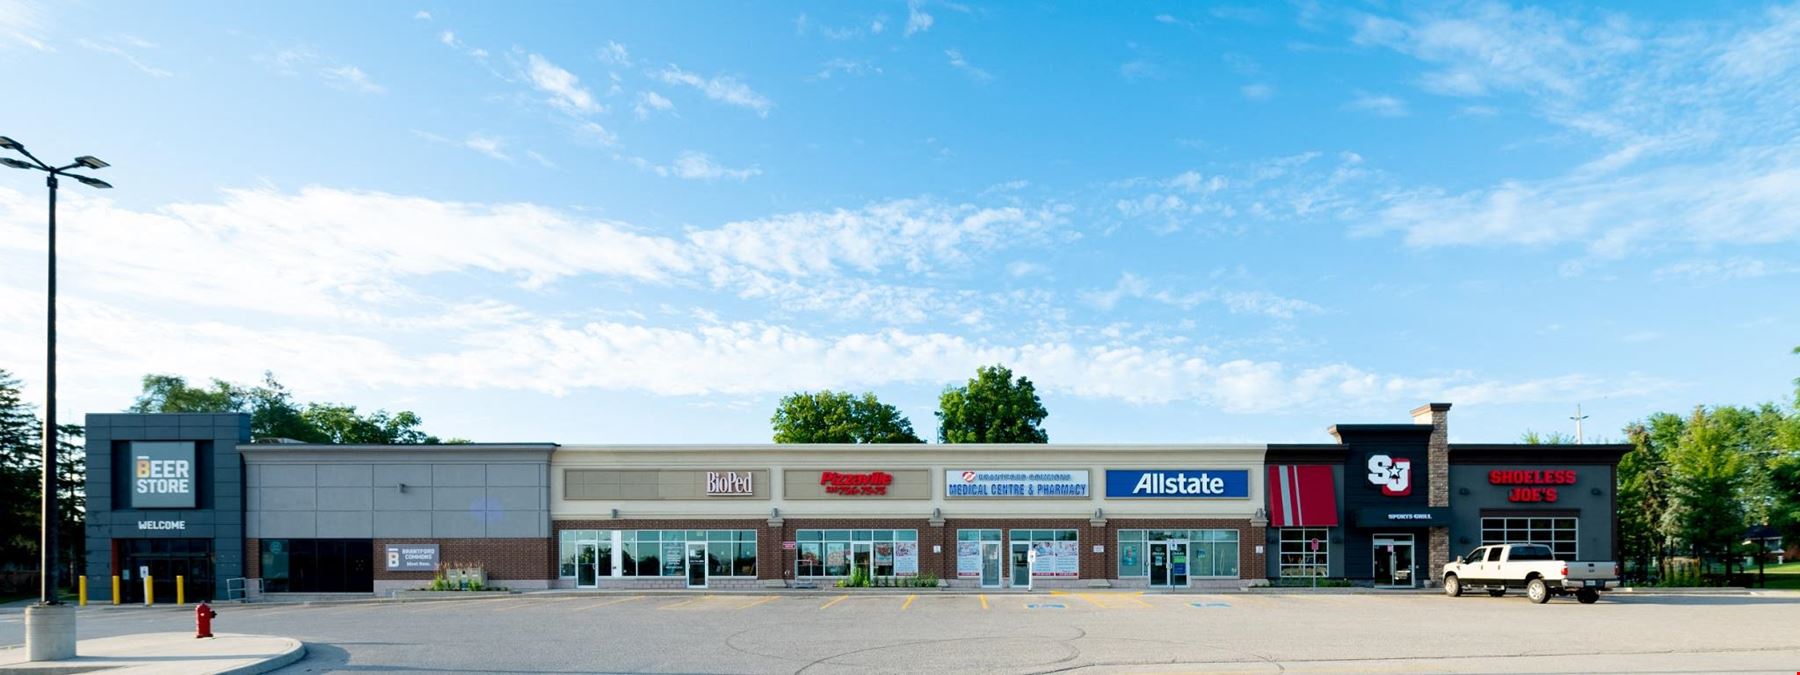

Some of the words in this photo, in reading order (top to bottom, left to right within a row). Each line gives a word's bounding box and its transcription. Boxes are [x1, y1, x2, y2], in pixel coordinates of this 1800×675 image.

[136, 456, 189, 478] BEER
[706, 471, 753, 493] BioPed
[821, 471, 893, 486] Pizzaville
[1132, 473, 1225, 494] Allstate
[1488, 470, 1577, 485] SHOELESS
[136, 479, 189, 493] STORE
[948, 484, 989, 496] MEDICAL
[990, 484, 1025, 496] CENTRE
[1028, 484, 1034, 496] &
[1037, 484, 1087, 496] PHARMACY
[1509, 487, 1557, 502] JOE'S
[138, 521, 186, 530] WELCOME
